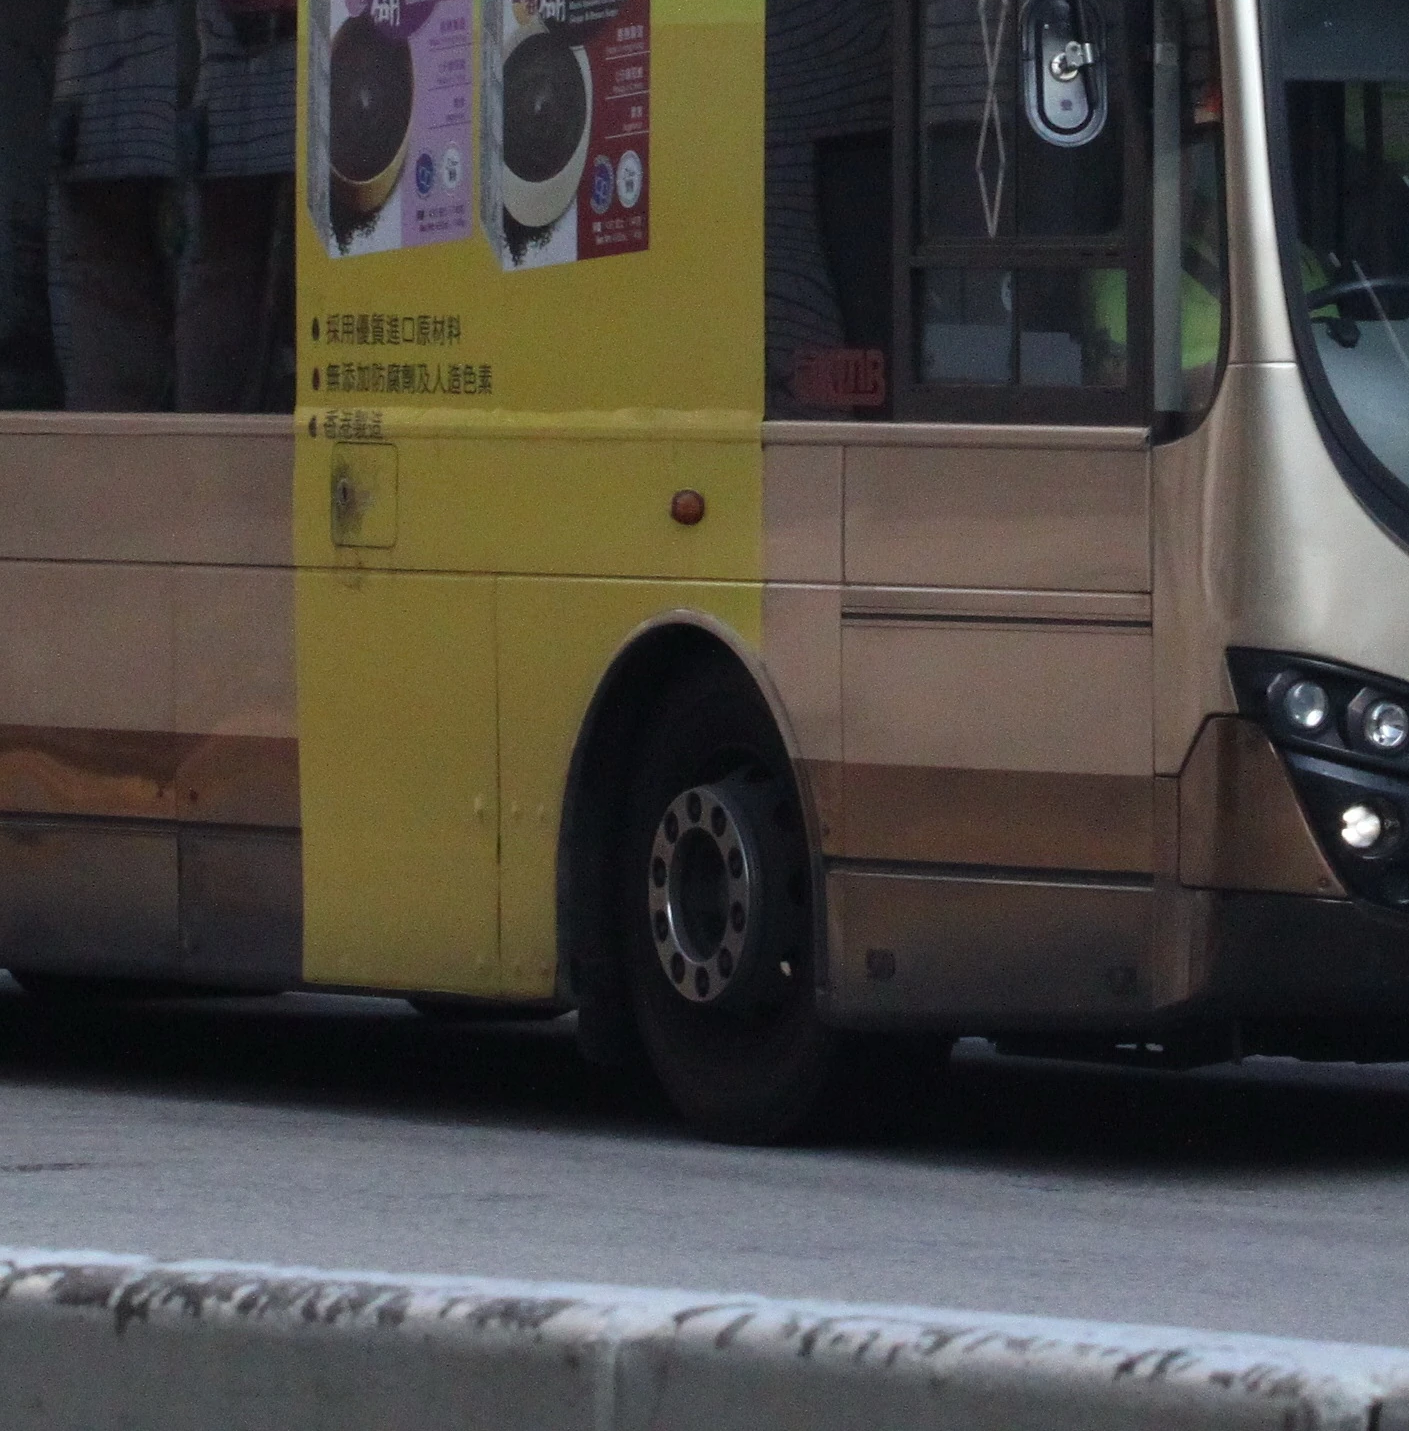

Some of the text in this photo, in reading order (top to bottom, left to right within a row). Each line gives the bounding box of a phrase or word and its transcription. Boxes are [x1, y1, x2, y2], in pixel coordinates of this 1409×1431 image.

[326, 313, 462, 347] 採用優質進口原材料
[326, 362, 493, 395] 無添加防腐劑及人造色素
